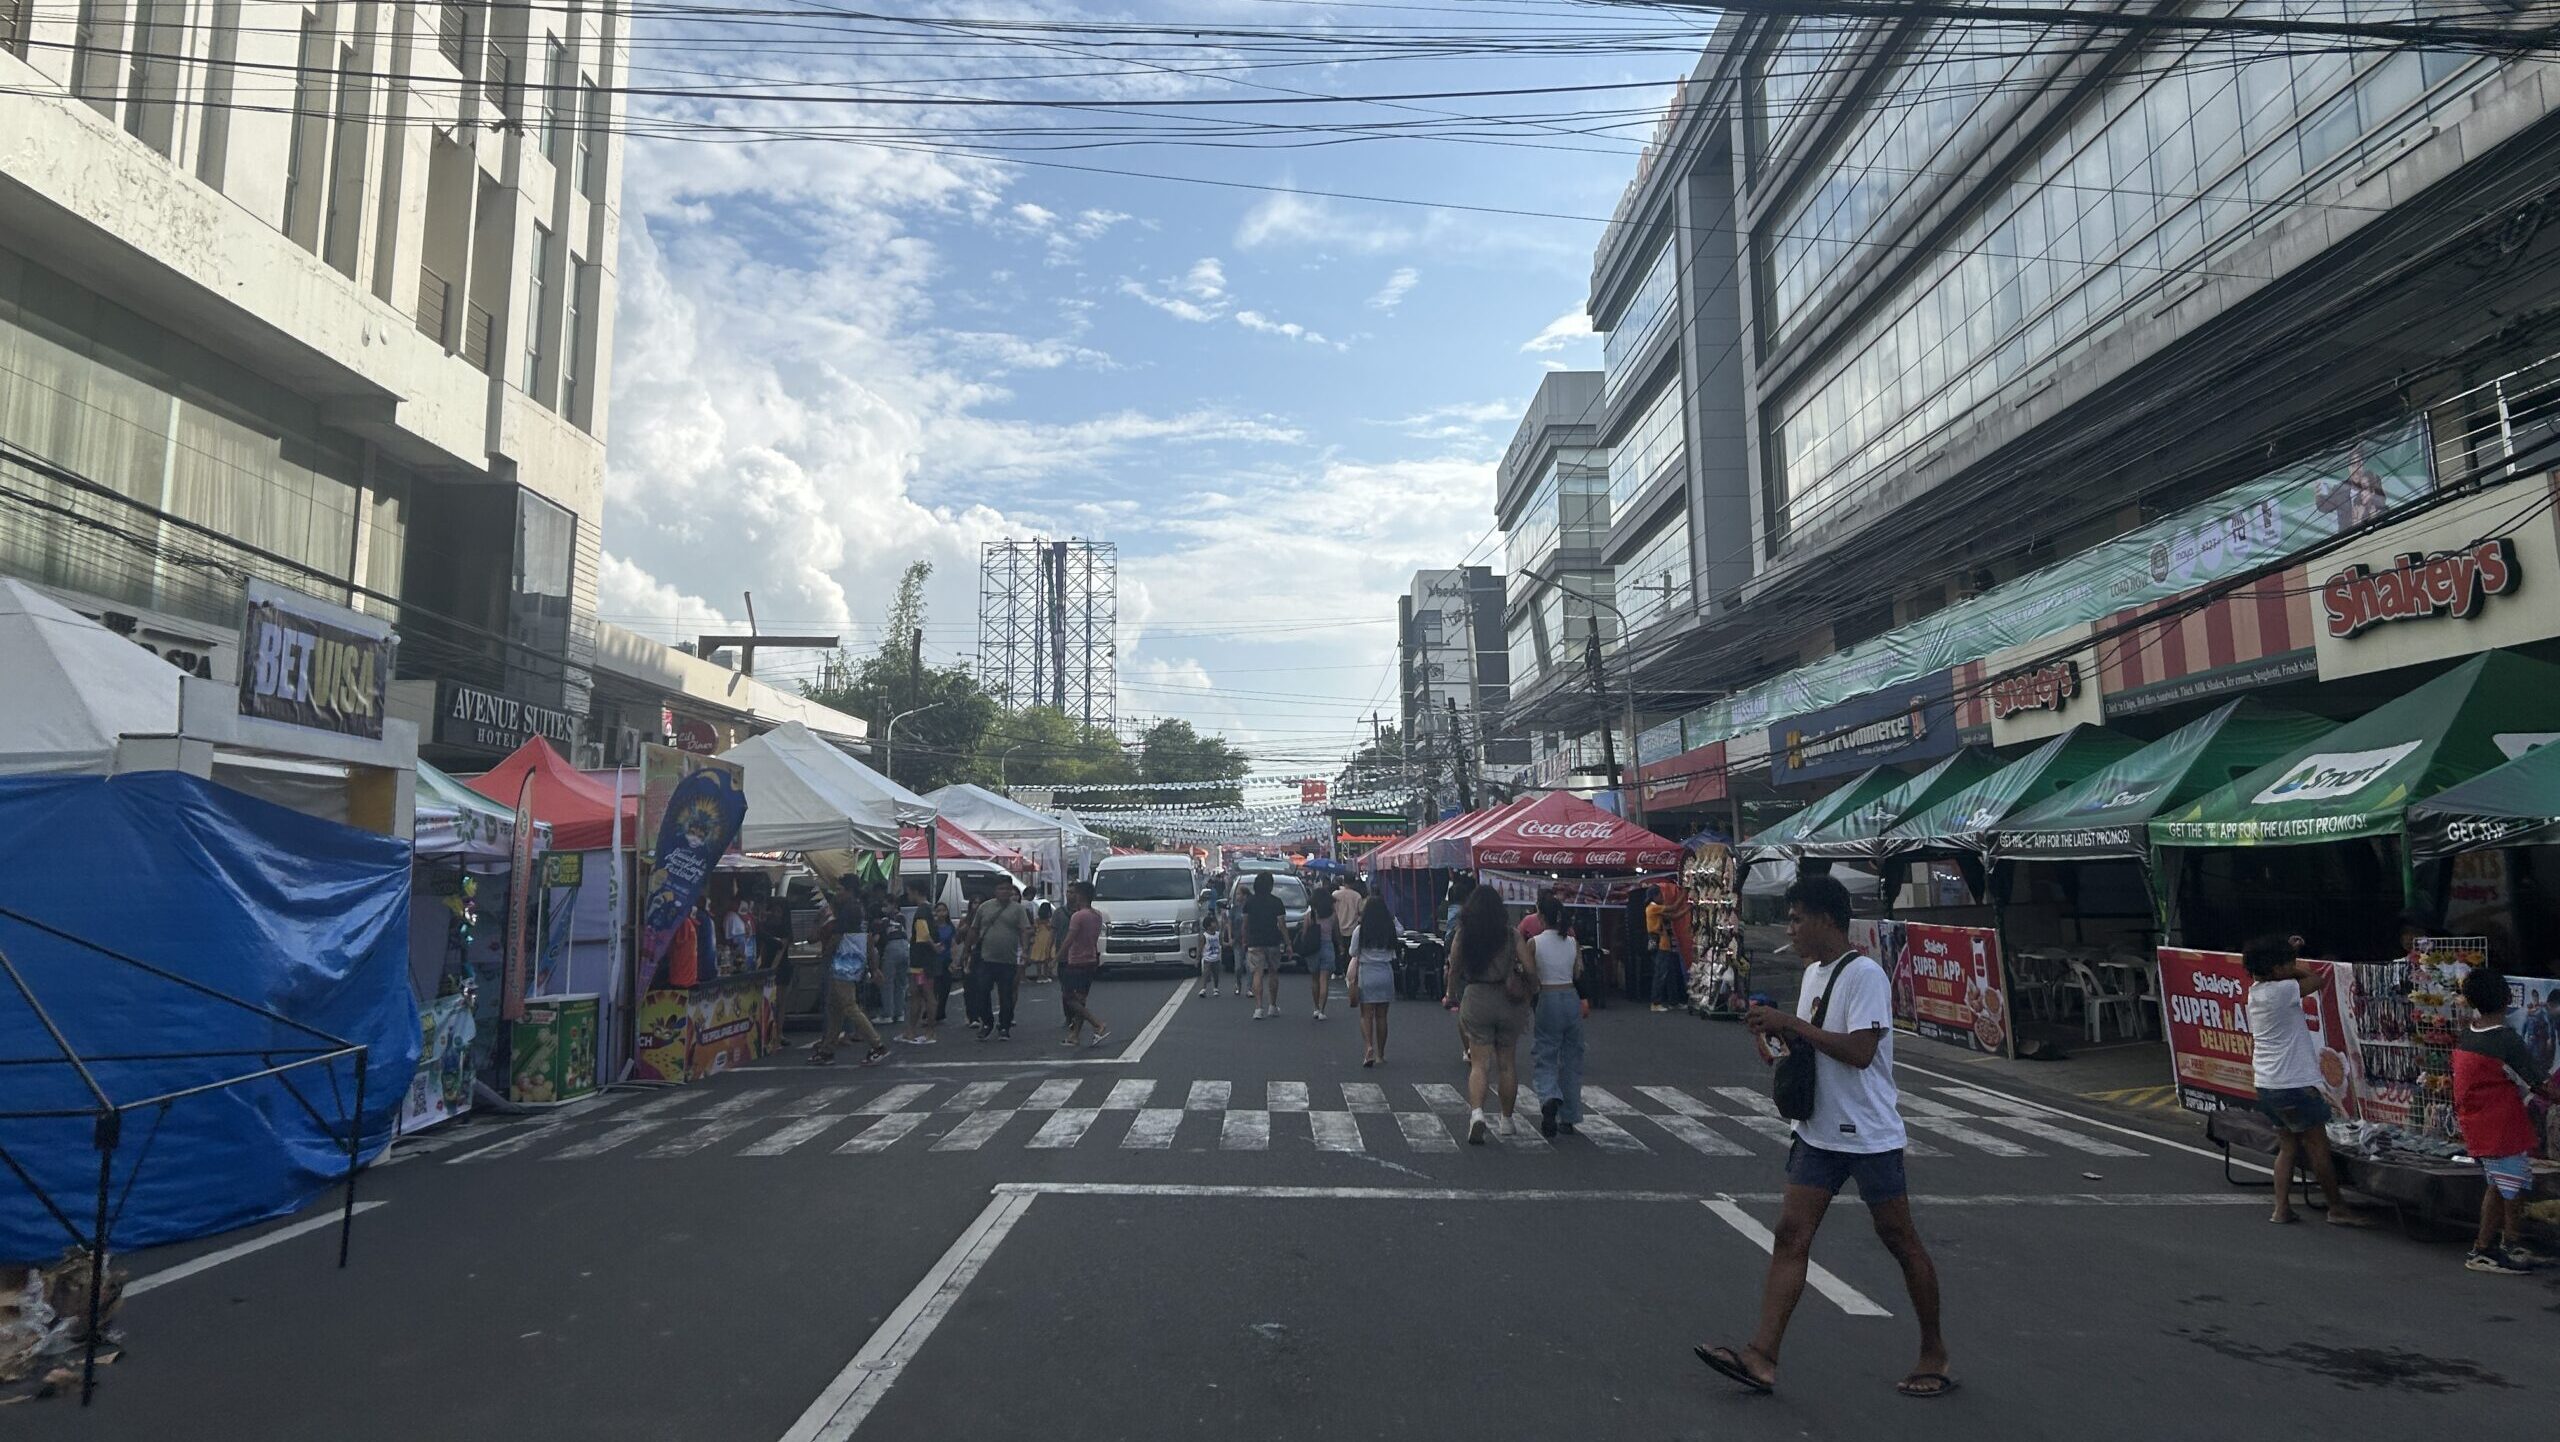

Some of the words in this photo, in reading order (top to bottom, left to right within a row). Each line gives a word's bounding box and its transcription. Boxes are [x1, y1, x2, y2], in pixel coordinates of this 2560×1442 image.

[2110, 583, 2128, 598] LOAD
[2323, 540, 2508, 638] Shakey's
[2282, 663, 2299, 677] Fresh
[2299, 660, 2316, 674] Salad
[453, 688, 519, 730] AVENUE
[524, 704, 574, 743] SUITES
[477, 727, 517, 749] HOTEL
[2301, 759, 2390, 791] Smart
[1517, 819, 1614, 839] Coca-Cola
[2169, 823, 2185, 838] GET
[2187, 823, 2202, 838] THE
[2220, 822, 2237, 839] APP
[2239, 821, 2257, 838] FOR
[2260, 821, 2277, 838] THE
[2279, 819, 2313, 837] LATEST
[2315, 813, 2368, 835] PROMOS!
[2447, 822, 2475, 842] GET
[2034, 834, 2046, 848] APP
[2048, 835, 2060, 848] FOR
[2061, 834, 2072, 847] THE
[2073, 832, 2096, 847] LATEST
[2096, 829, 2131, 845] PROMOS!
[1480, 850, 1521, 864] Coca-Cola
[1532, 850, 1575, 864] Coca-Cola
[1585, 851, 1627, 865] Coca-Cola
[1636, 851, 1677, 865] Coca-Cola
[1913, 955, 1937, 978] SUPER
[2192, 971, 2243, 998] Shakey's
[2171, 995, 2223, 1029] SUPER
[2200, 1030, 2253, 1057] DELIVERY
